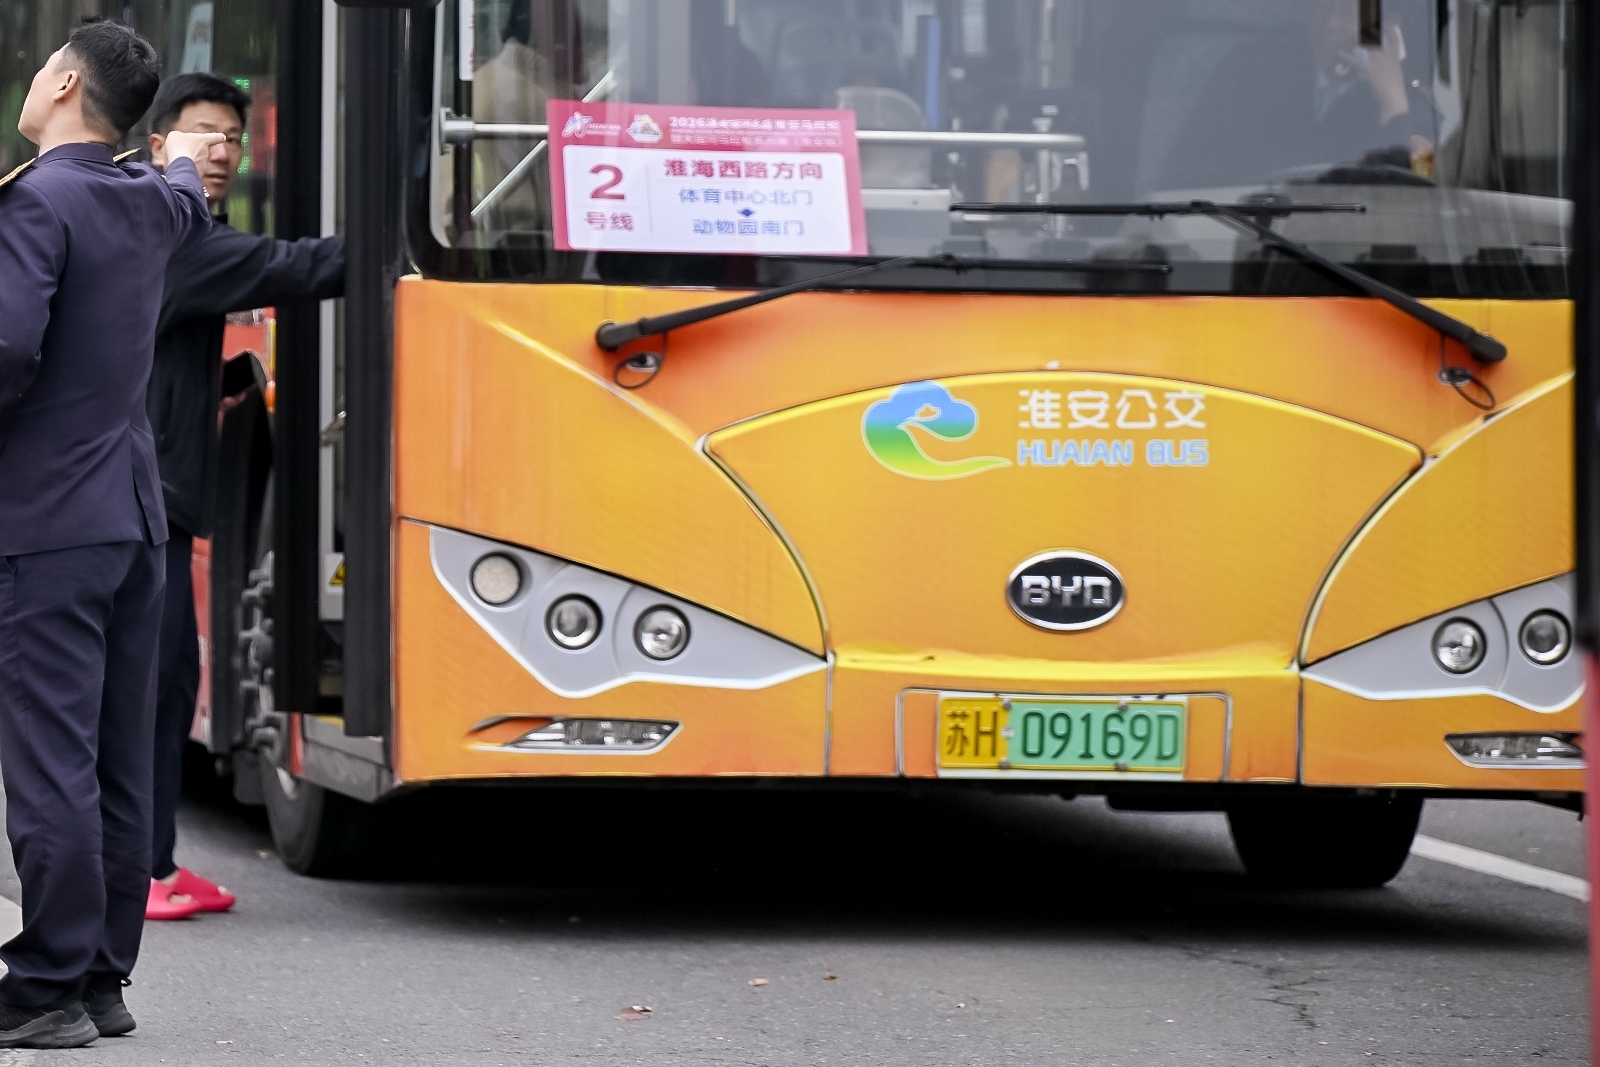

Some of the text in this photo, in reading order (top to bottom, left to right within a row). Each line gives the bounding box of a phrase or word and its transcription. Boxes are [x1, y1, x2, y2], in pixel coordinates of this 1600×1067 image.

[588, 163, 626, 201] 2
[664, 158, 824, 181] 淮海西路方向
[678, 187, 815, 207] 体育中心北门
[584, 211, 635, 233] 号线
[692, 218, 805, 238] 动物园南门
[1018, 389, 1208, 430] 淮安公交
[1017, 439, 1209, 468] HUAIAN BUS
[1020, 574, 1112, 608] BYD
[944, 708, 1180, 761] 苏H 09169D
